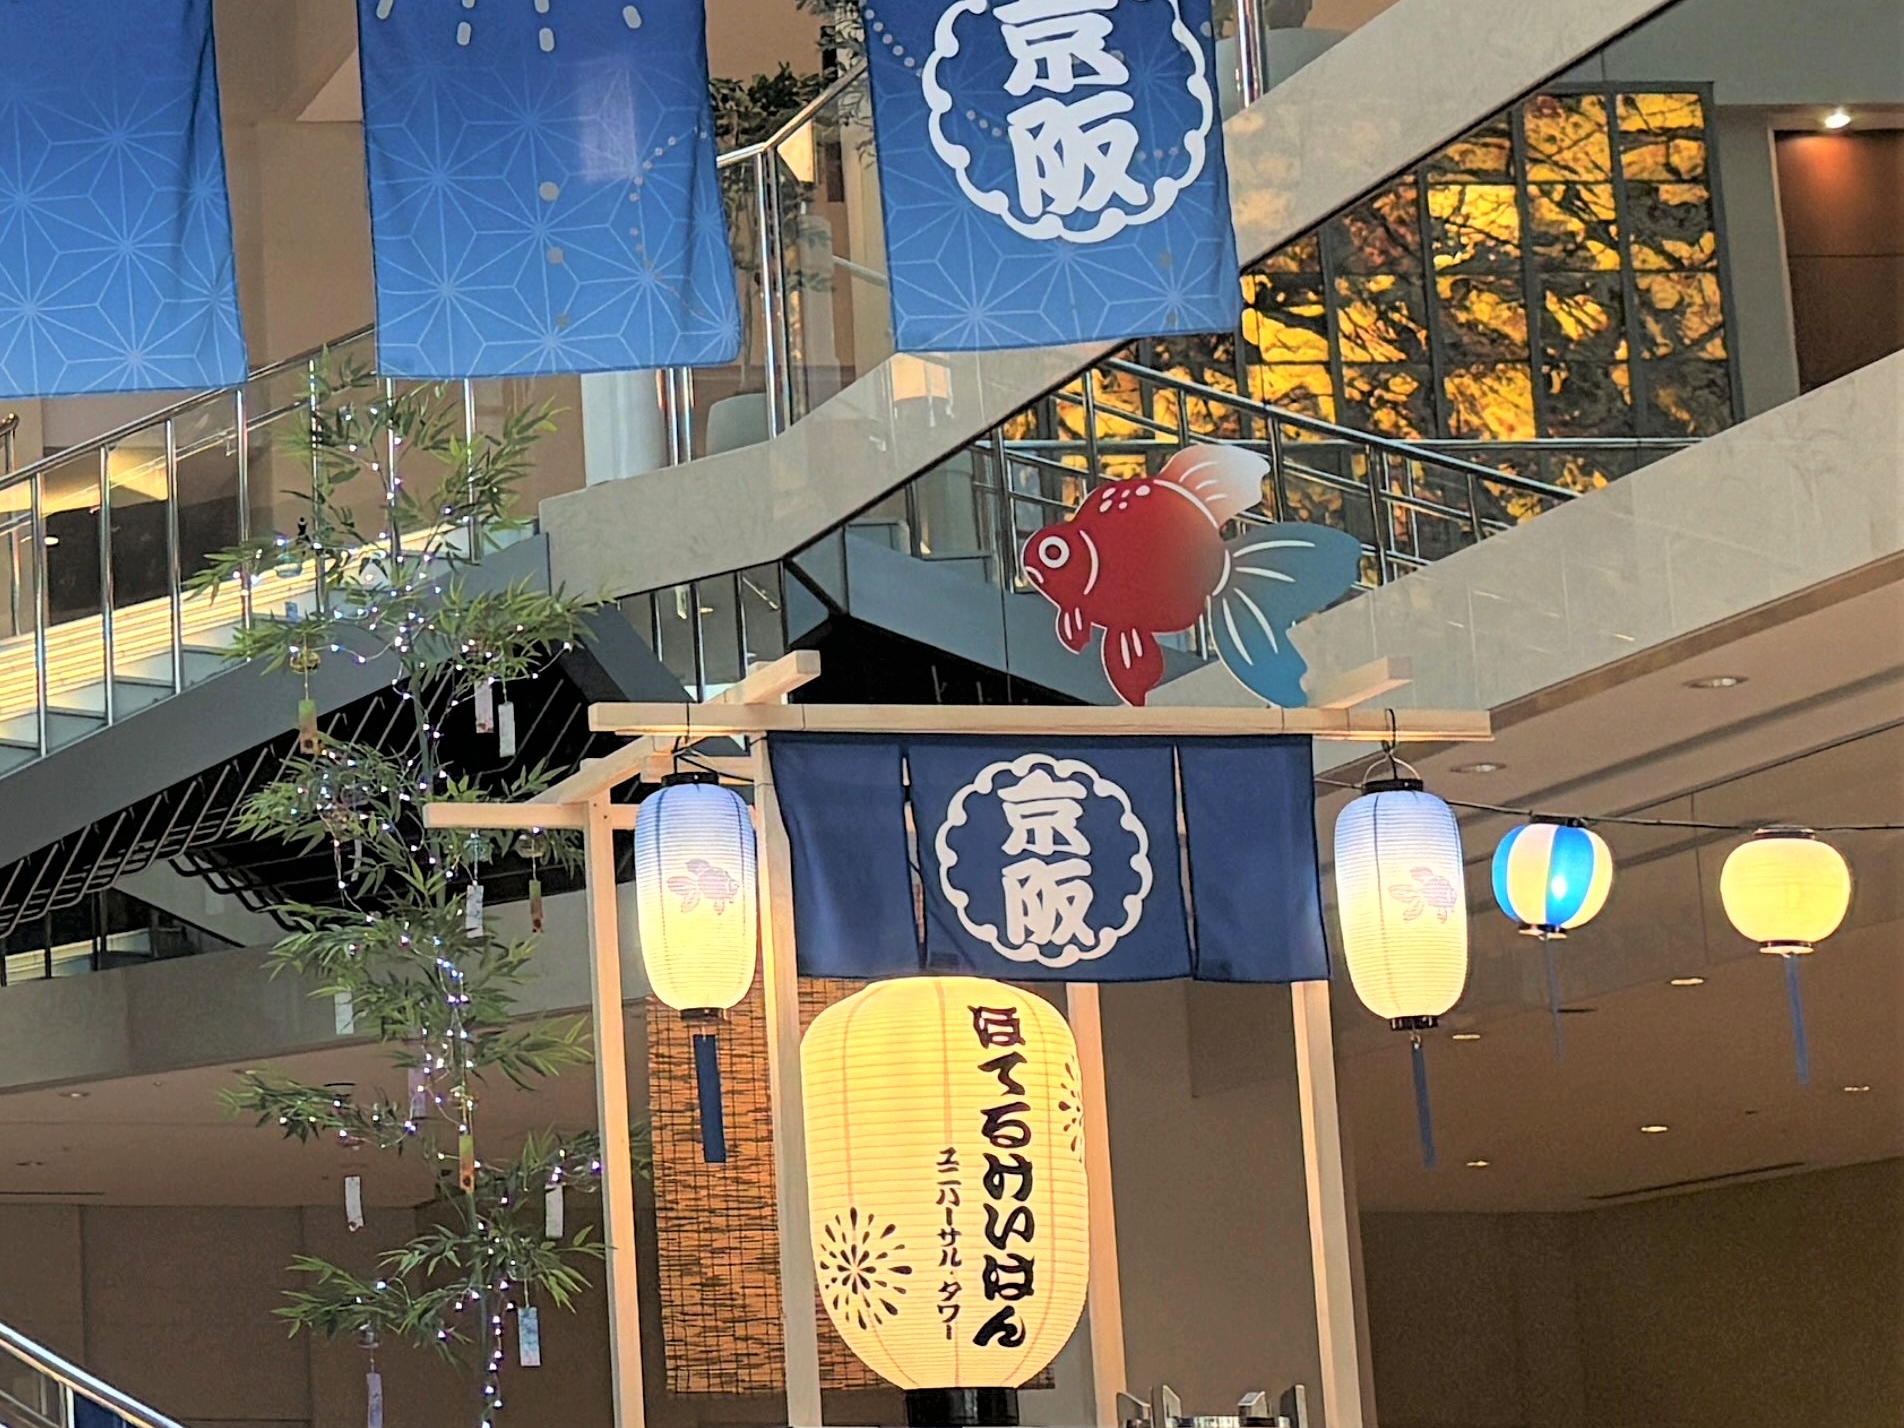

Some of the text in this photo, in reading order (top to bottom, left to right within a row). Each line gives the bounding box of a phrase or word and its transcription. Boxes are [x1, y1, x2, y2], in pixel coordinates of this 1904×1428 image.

[998, 769, 1097, 948] 京阪
[967, 1004, 1036, 1349] ほてるけいはん
